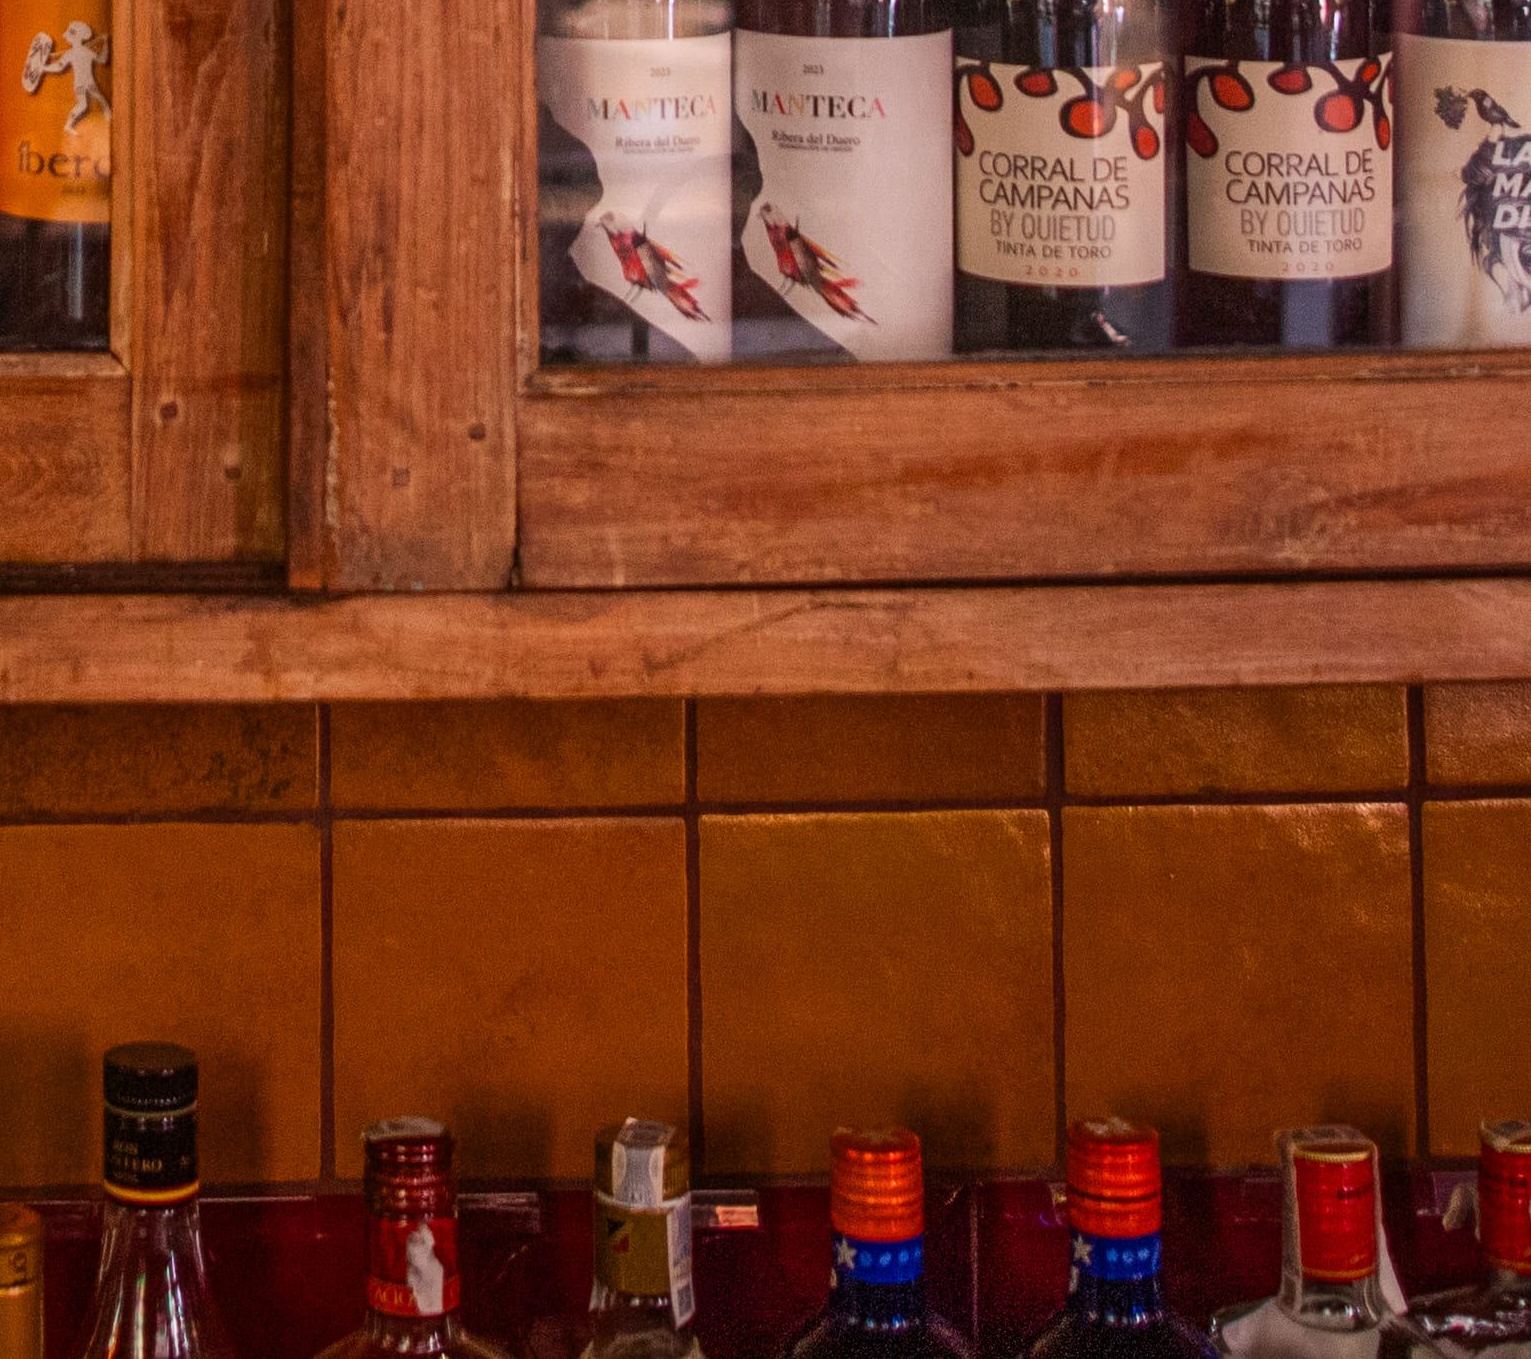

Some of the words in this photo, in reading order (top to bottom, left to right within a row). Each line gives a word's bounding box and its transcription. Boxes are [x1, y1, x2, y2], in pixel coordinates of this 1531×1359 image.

[589, 94, 717, 122] MANTECA
[751, 88, 886, 120] MANTECA
[654, 135, 673, 148] del
[770, 129, 805, 145] Ribera
[806, 132, 825, 145] del
[978, 149, 1085, 183] CORRAL
[1092, 155, 1128, 183] DE
[1225, 149, 1340, 178] CORRAL
[1345, 147, 1374, 176] DE
[978, 178, 1131, 212] CAMPANAS
[1225, 175, 1376, 207] CAMPANAS
[990, 208, 1016, 239] BY
[1021, 212, 1117, 243] QUIETUD
[1241, 208, 1269, 235] BY
[1276, 206, 1366, 238] QUIETUD
[996, 239, 1037, 259] TINTA
[1042, 244, 1064, 259] DE
[1069, 245, 1113, 260] TORO
[1248, 238, 1293, 254] TINTA
[1299, 239, 1319, 254] DE
[1326, 237, 1363, 254] TORO
[1025, 264, 1080, 278] 2020
